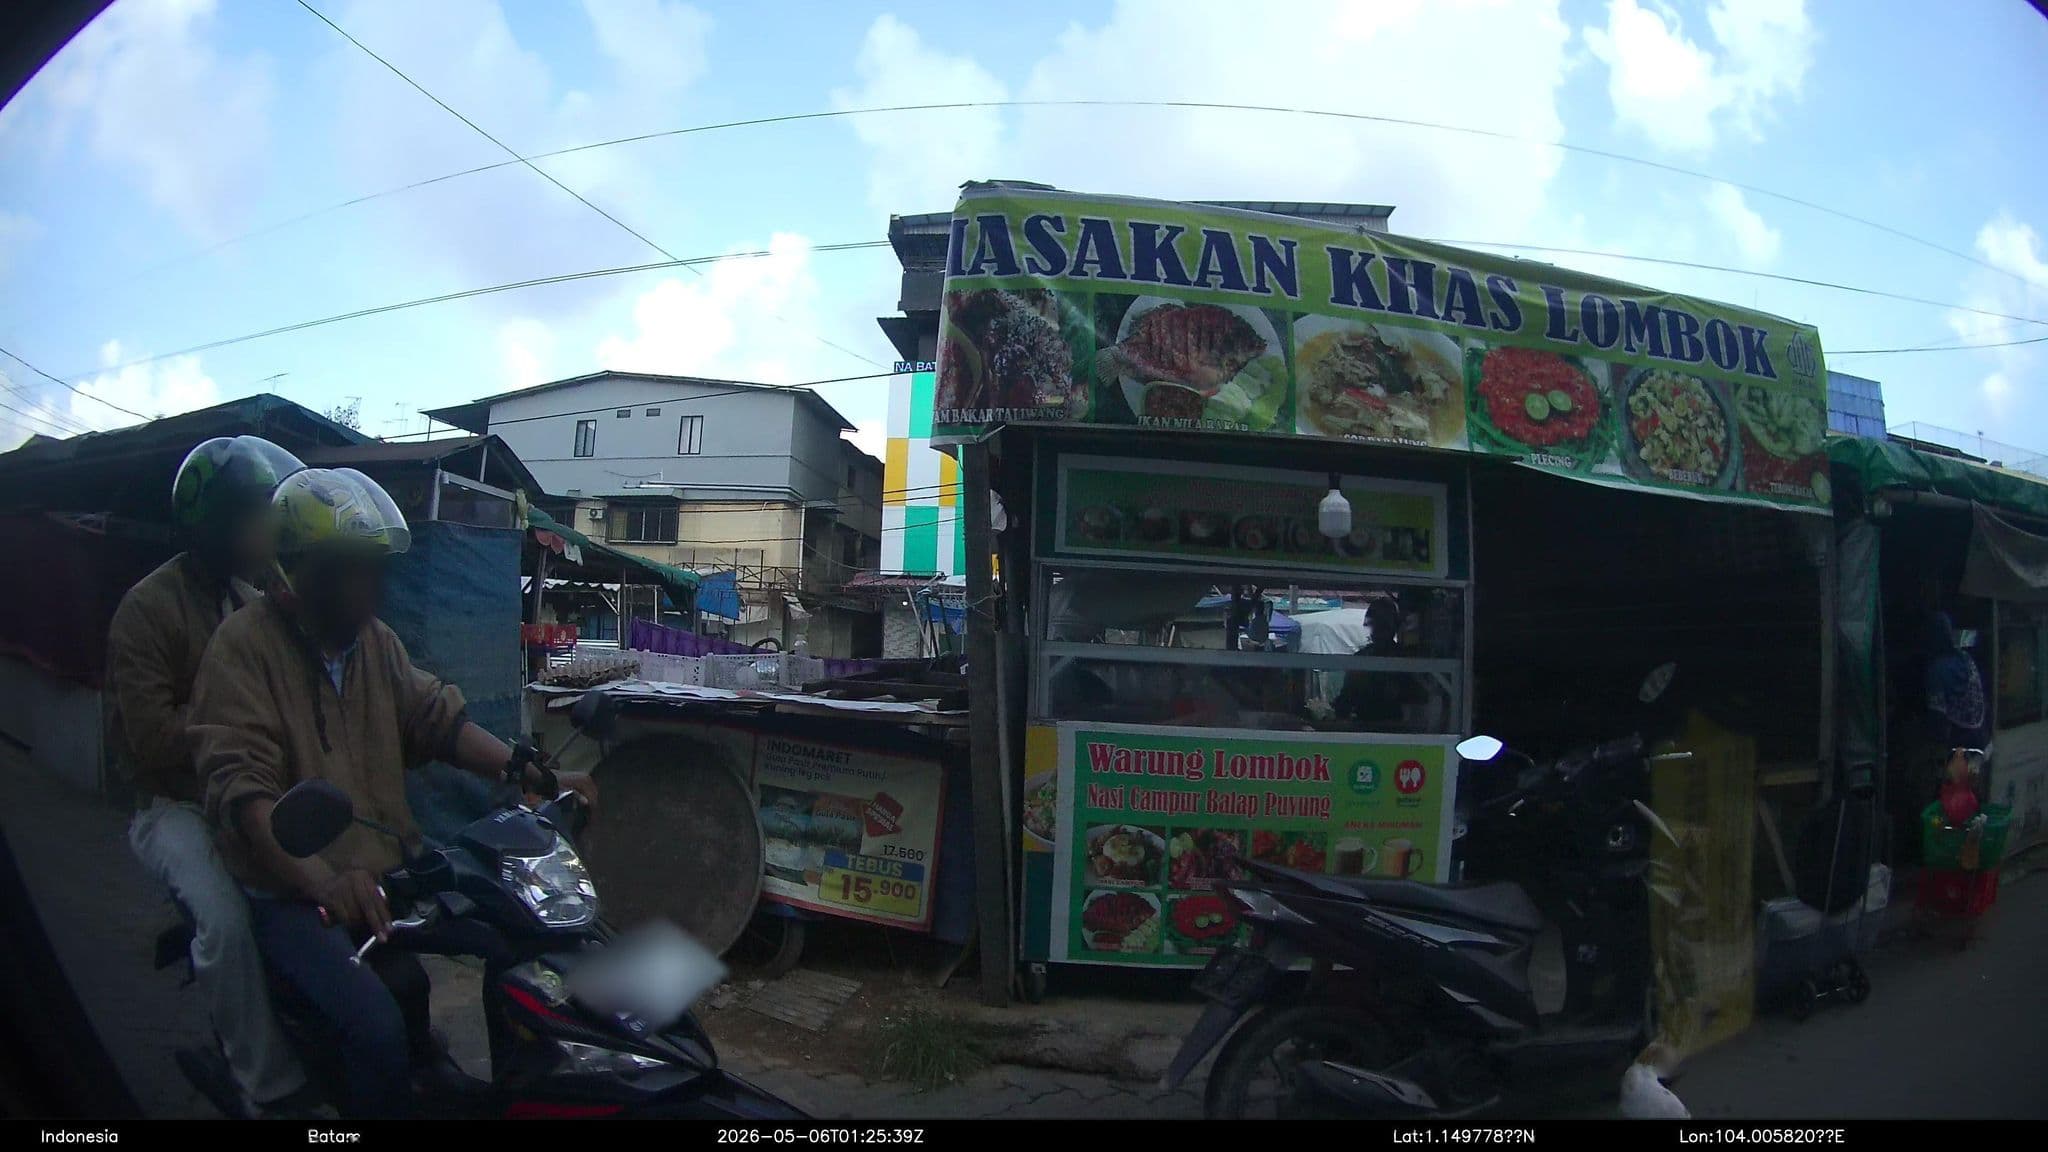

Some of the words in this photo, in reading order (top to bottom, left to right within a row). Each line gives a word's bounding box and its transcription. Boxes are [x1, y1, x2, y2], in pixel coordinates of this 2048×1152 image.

[1324, 246, 1524, 333] KHAS
[1540, 284, 1779, 380] LOMBOK
[951, 408, 994, 423] BAKAR
[1137, 415, 1171, 429] IKAN
[1530, 453, 1573, 469] PLECING
[767, 741, 853, 765] INDOMARET
[1087, 742, 1203, 780] Warung
[1213, 750, 1330, 782] Lombok
[1087, 782, 1124, 809] Nasi
[1129, 785, 1201, 816] Campur
[848, 854, 903, 877] TEBUS
